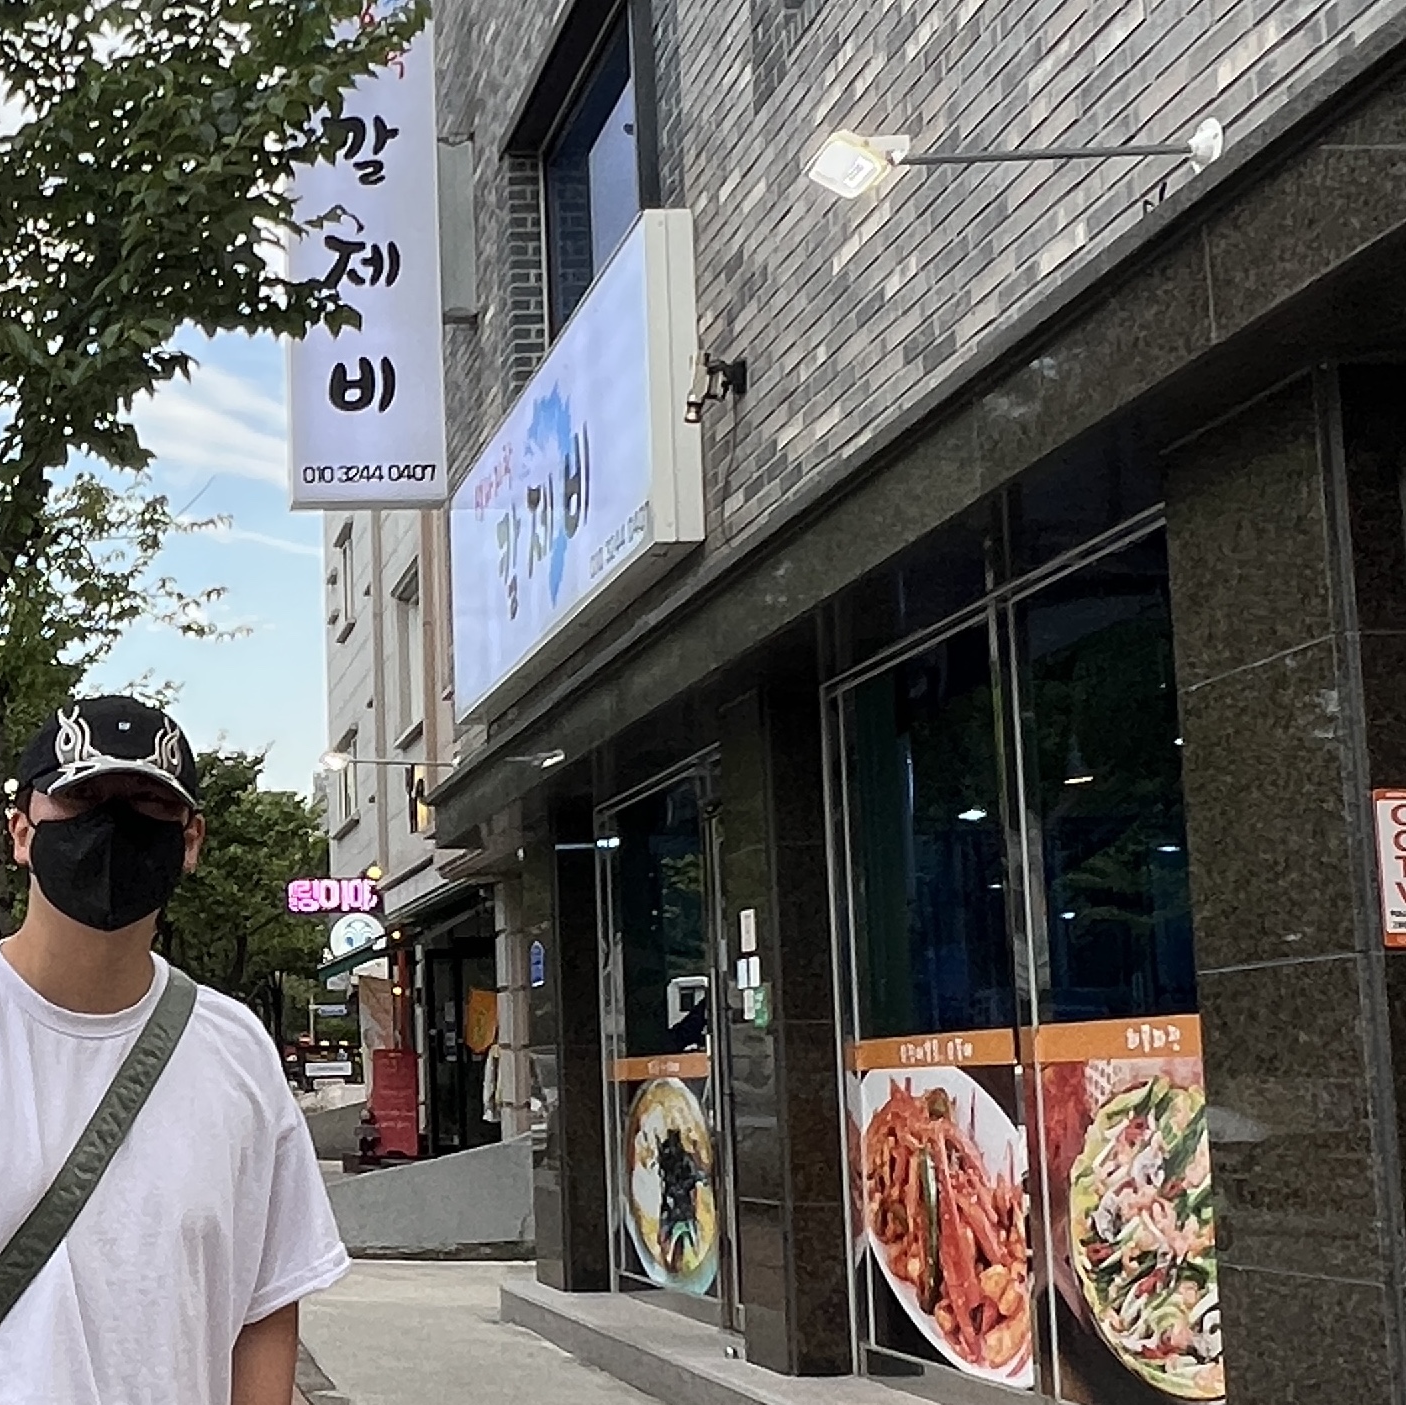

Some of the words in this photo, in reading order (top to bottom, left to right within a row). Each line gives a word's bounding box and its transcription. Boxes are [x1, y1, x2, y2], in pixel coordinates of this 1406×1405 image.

[303, 465, 333, 483] 010
[337, 464, 383, 483] 3244
[388, 463, 436, 482] 0407
